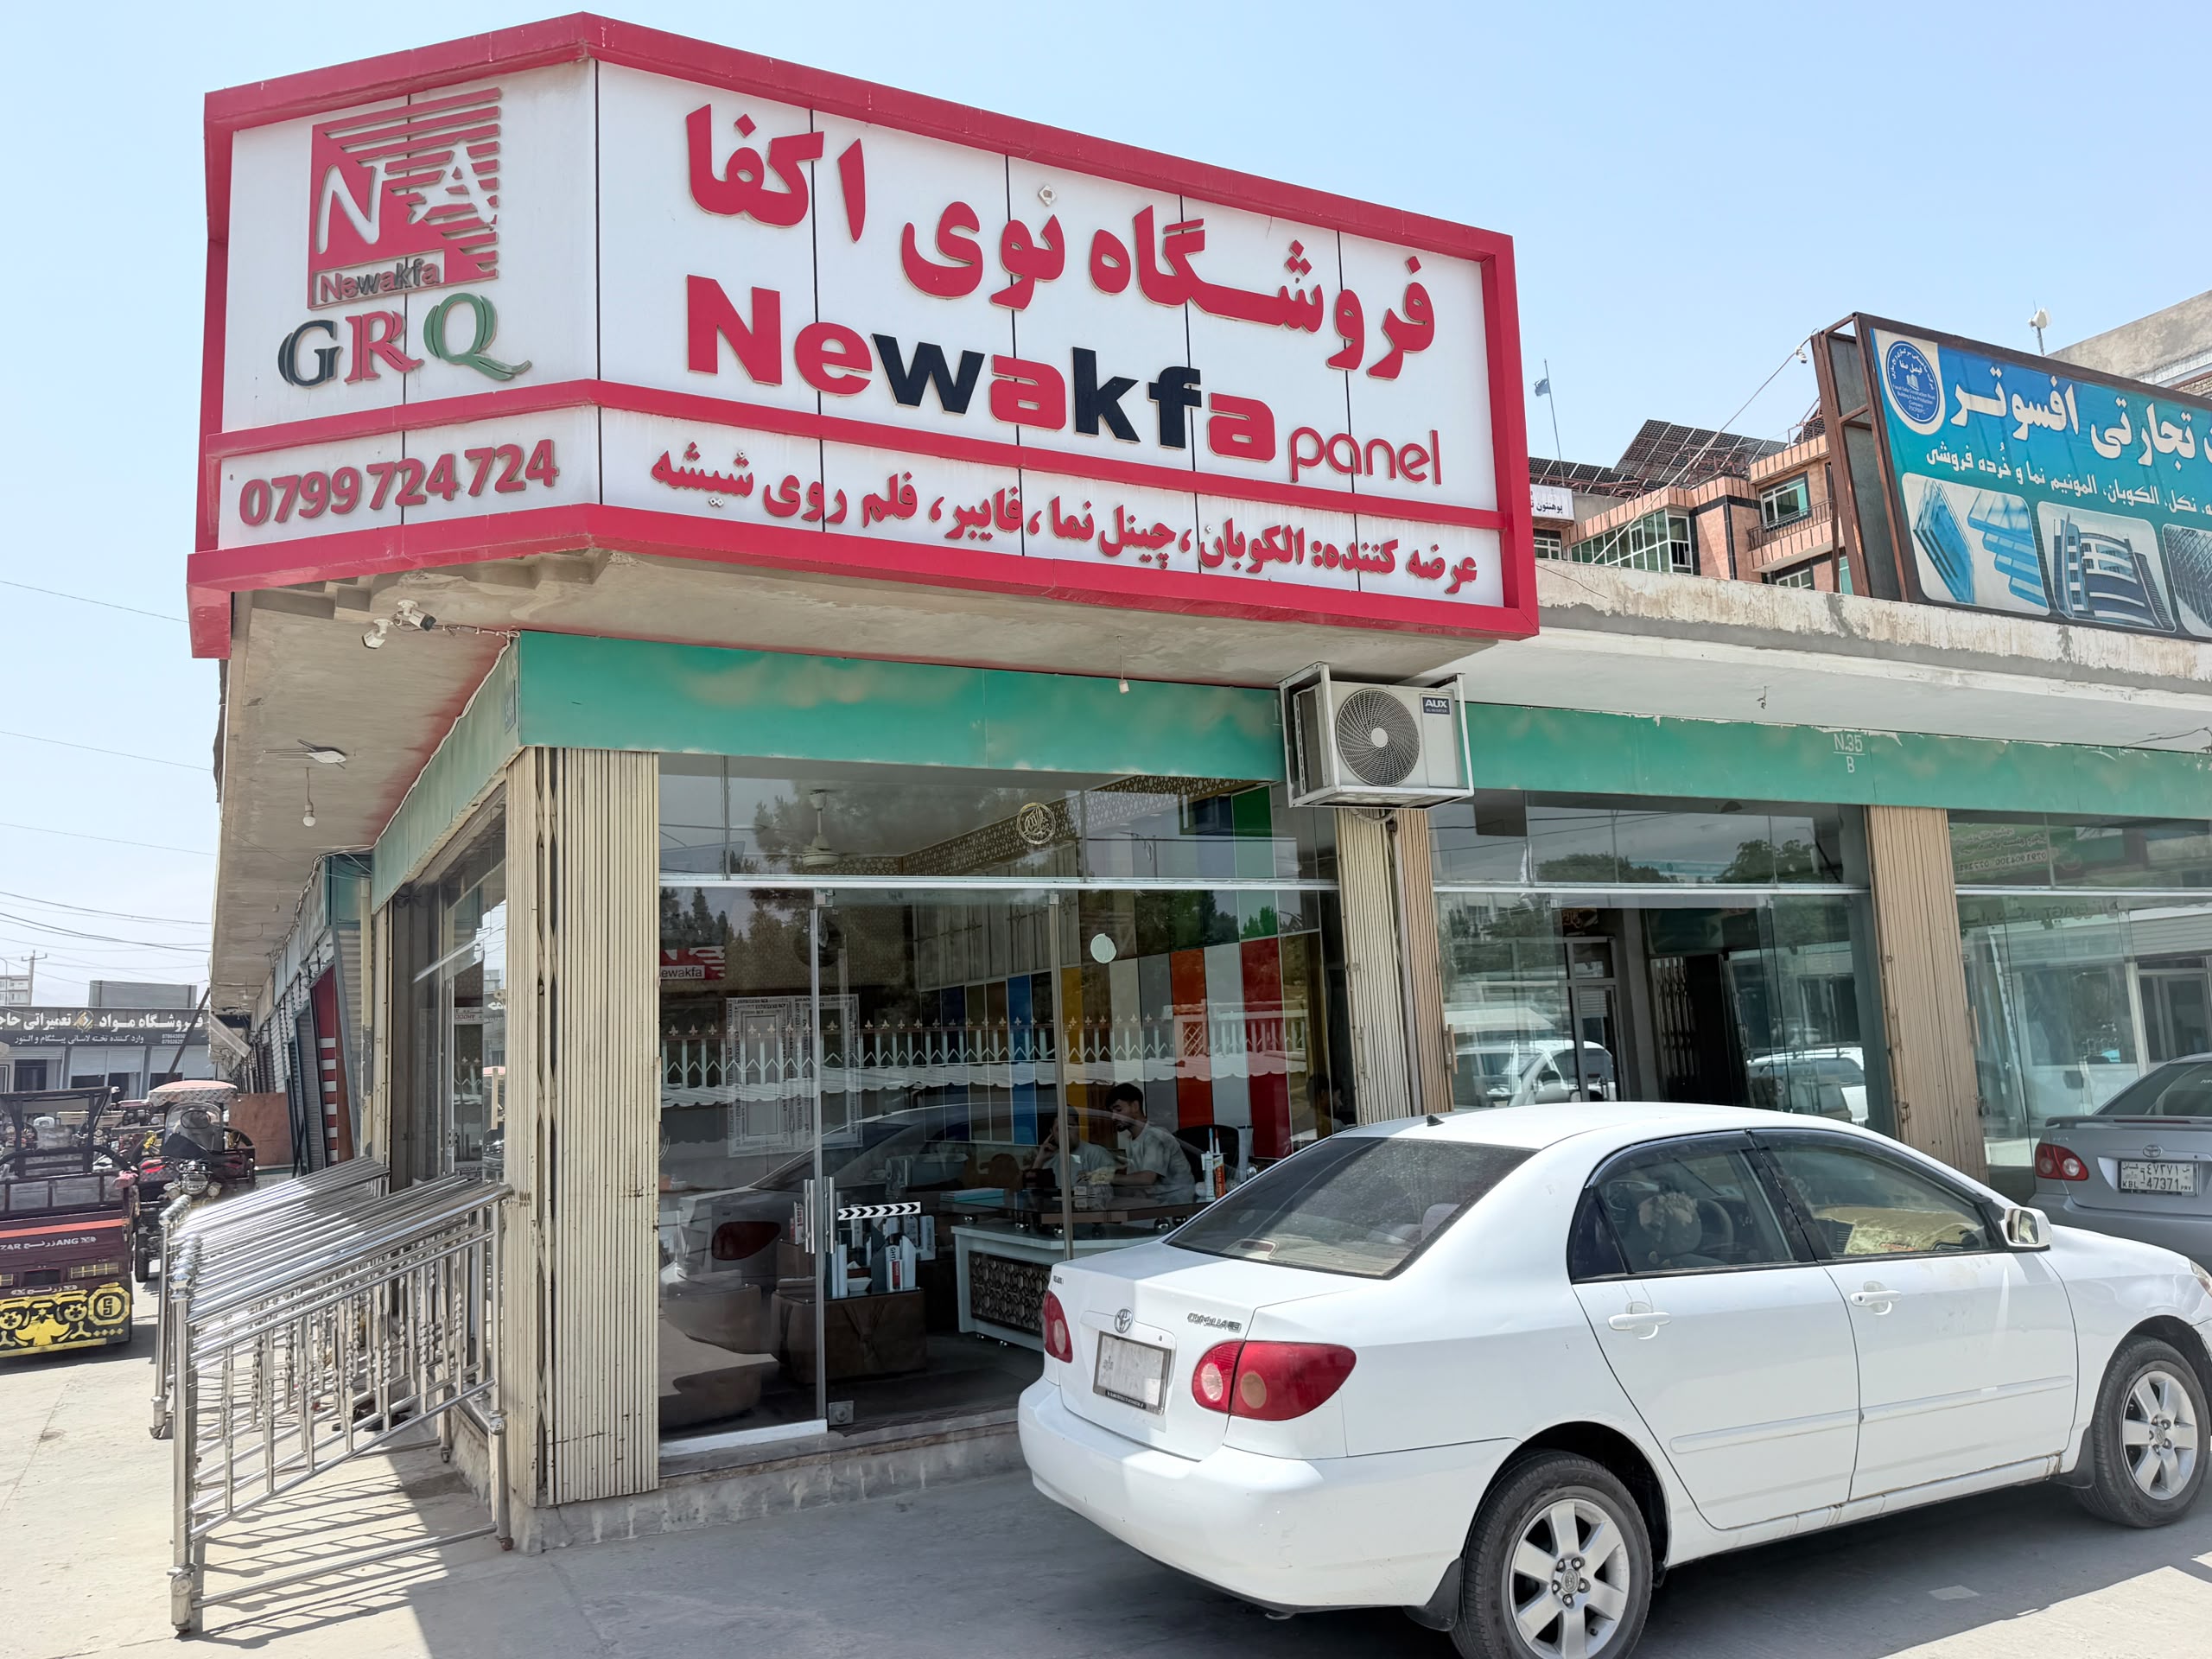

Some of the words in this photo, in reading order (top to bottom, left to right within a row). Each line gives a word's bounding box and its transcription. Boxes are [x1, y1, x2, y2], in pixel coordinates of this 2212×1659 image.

[684, 103, 865, 243] اکفا
[320, 258, 441, 302] Newakfa
[1090, 204, 1435, 379] فروشگاه
[278, 292, 532, 389] GRQ
[687, 273, 1277, 463] Newakfa
[1289, 429, 1443, 486] panel
[2090, 397, 2196, 471] تجارتی
[651, 441, 753, 508] شیشه
[1926, 441, 1974, 472] فروشی
[2015, 466, 2024, 486] و
[763, 467, 847, 524] روی
[1406, 543, 1478, 594] عرضه
[1425, 699, 1448, 709] AUX
[1847, 756, 1855, 773] B
[661, 967, 702, 977] ewakfa
[23, 1013, 72, 1031] تعمیراتی
[99, 1013, 136, 1033] مواد
[138, 1013, 204, 1033] فروشگاه
[2122, 1180, 2139, 1189] KBL
[2146, 1177, 2179, 1191] 47371
